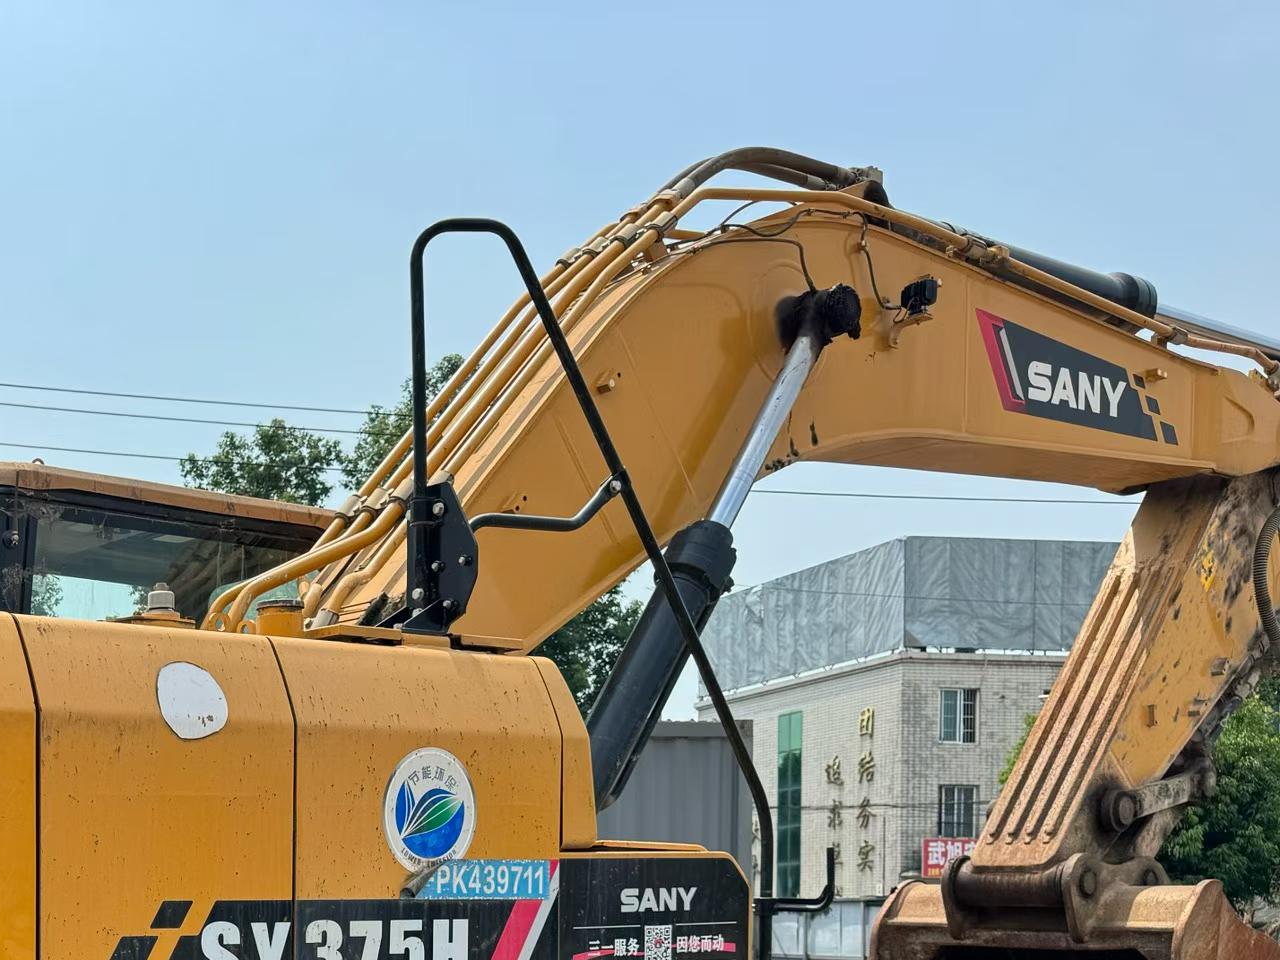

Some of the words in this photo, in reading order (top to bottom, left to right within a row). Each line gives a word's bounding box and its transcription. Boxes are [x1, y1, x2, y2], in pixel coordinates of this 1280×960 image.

[1027, 360, 1127, 418] SANY
[408, 765, 457, 791] 节能环保
[620, 887, 697, 913] SANY
[588, 938, 640, 957] 三一服务
[675, 934, 725, 953] 因您而动
